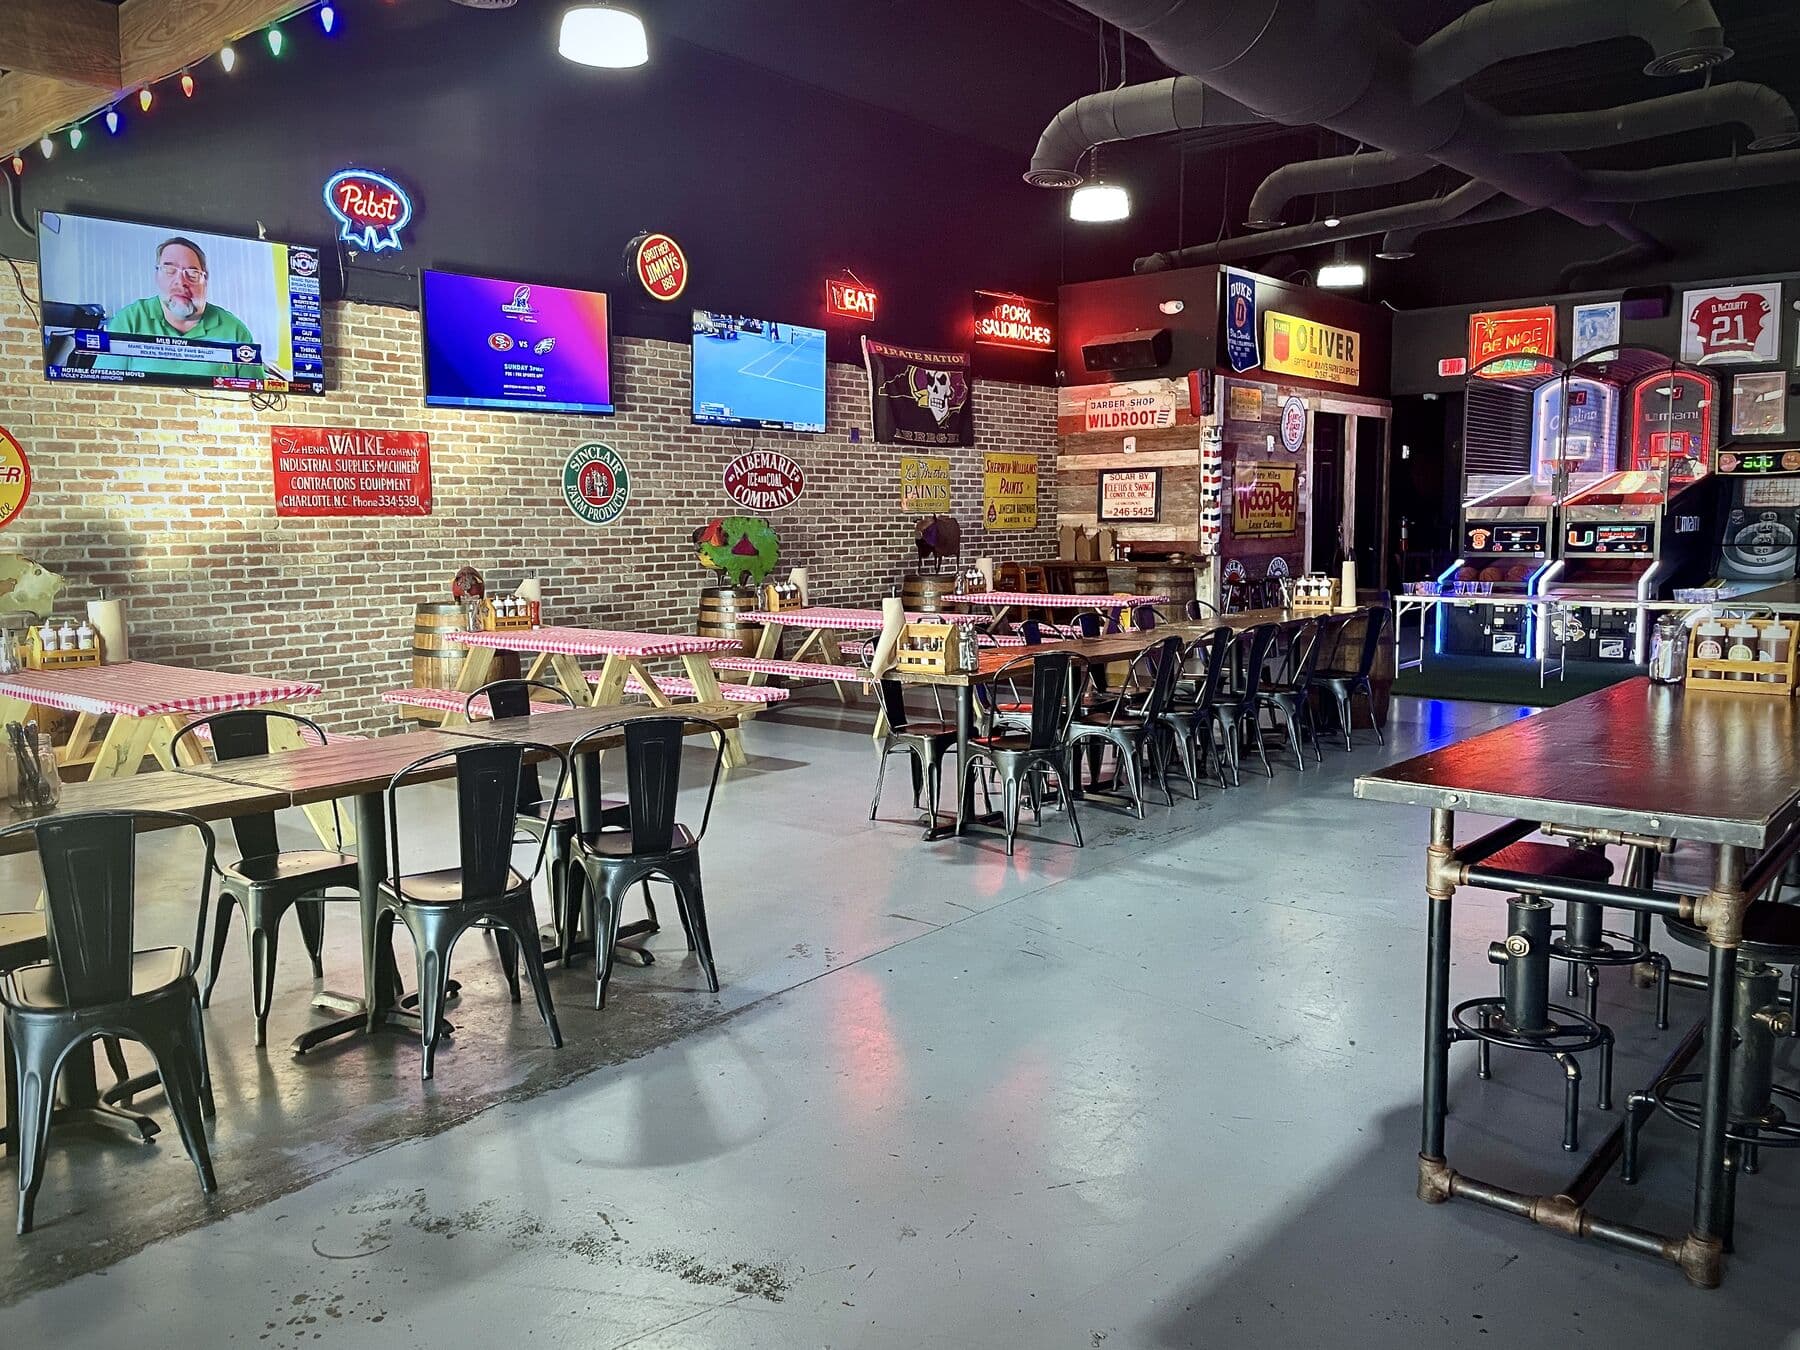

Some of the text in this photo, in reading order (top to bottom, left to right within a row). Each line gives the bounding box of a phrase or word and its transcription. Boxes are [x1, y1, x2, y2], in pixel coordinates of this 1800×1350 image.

[340, 184, 399, 220] Pabst
[642, 240, 670, 263] BROTHER
[661, 274, 677, 291] BBQ
[1230, 281, 1253, 303] DUKE
[1001, 303, 1032, 325] PORK
[981, 318, 1051, 344] SANDWICHES
[1709, 315, 1747, 347] 21
[155, 337, 171, 345] MLB
[1296, 324, 1355, 363] OLIVER
[1481, 337, 1502, 356] BE
[875, 345, 922, 361] PIRATE
[90, 369, 125, 377] OFFSEASON
[504, 363, 528, 371] SUNDAY
[1130, 397, 1155, 407] SHOP
[1576, 393, 1585, 404] 0
[1088, 410, 1157, 429] WILDROOT
[279, 434, 421, 457] The HENRY WALKE COMPANY
[279, 457, 333, 473] INDUSTRIAL
[570, 446, 622, 474] SINCLAIR
[732, 453, 800, 481] ALBEMARLE
[985, 459, 1037, 475] SHERWIN-WILLIAMS
[290, 475, 412, 491] CONTRACTORS EQUIPMENT
[747, 472, 759, 487] ICE
[766, 472, 783, 488] COAL
[1138, 472, 1149, 480] BY
[1267, 471, 1281, 480] Miles
[904, 484, 948, 499] PAINTS
[999, 477, 1024, 495] PAINTS
[352, 495, 378, 507] Phone
[566, 484, 627, 521] FARM PRODUCTS
[733, 482, 797, 508] COMPANY
[1112, 507, 1154, 516] 246-5425
[1248, 520, 1283, 529] Less Carbon
[1568, 531, 1594, 547] U
